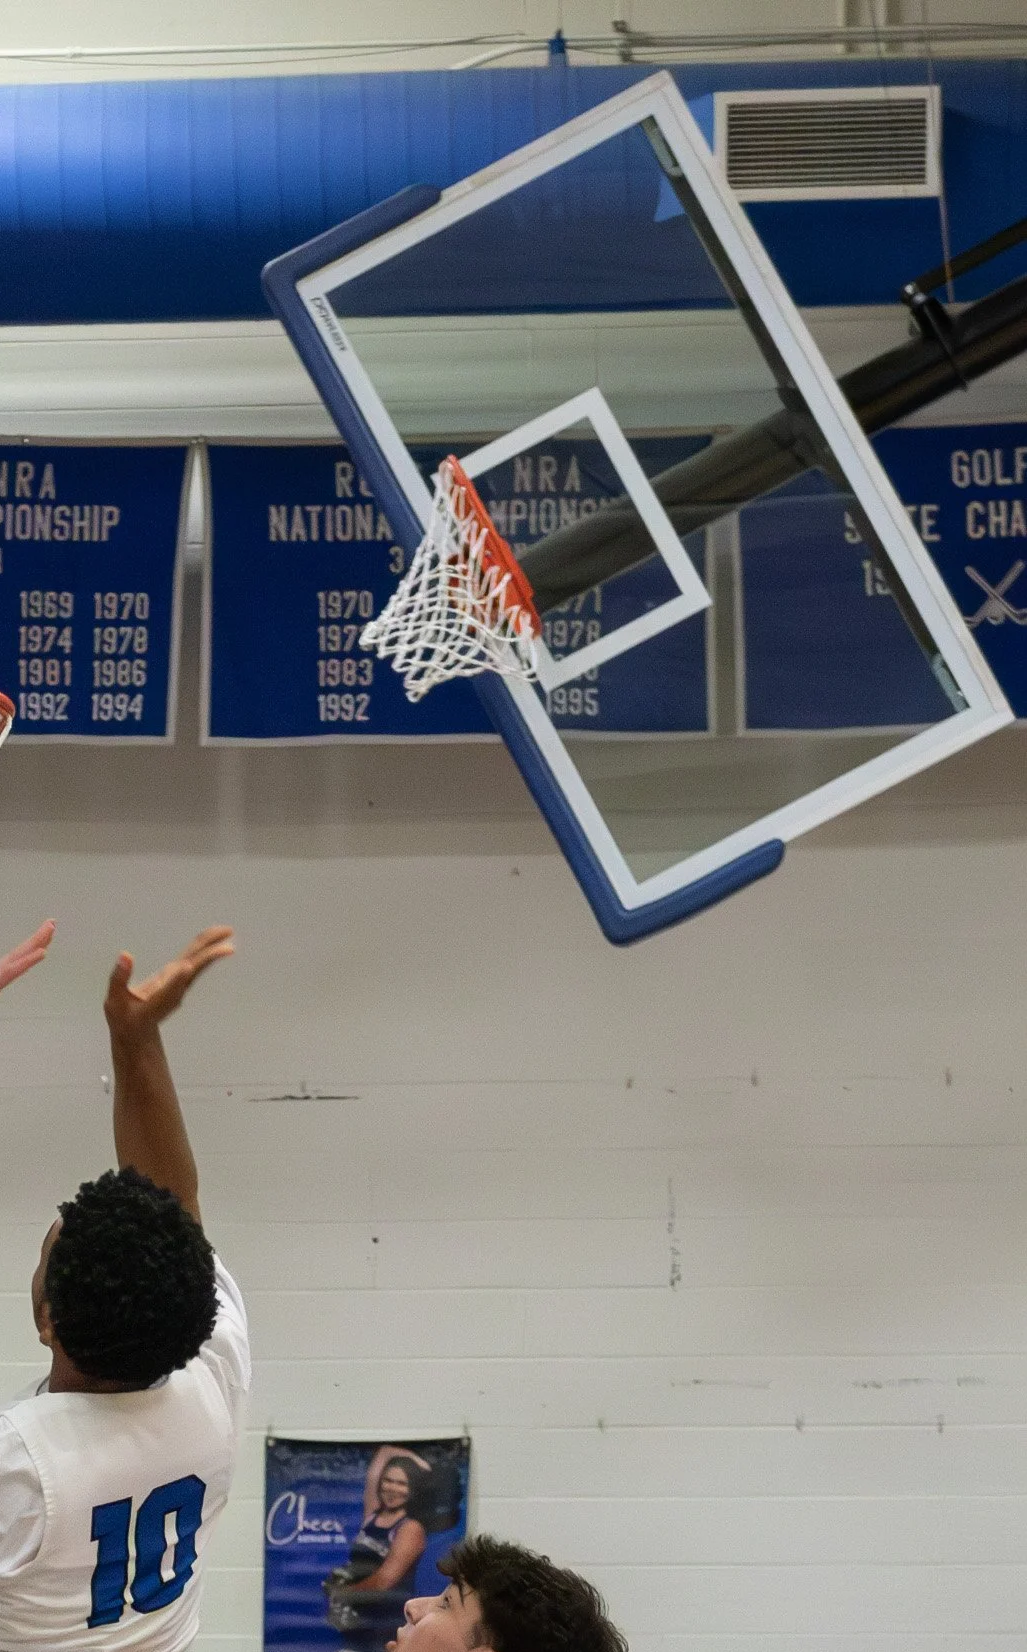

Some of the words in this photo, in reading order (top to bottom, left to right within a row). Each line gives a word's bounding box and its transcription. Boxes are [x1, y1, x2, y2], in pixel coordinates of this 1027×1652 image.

[513, 455, 581, 492] NRA
[951, 446, 1027, 488] GOLF
[268, 504, 394, 542] NATIONA
[19, 590, 74, 618] 1969
[93, 592, 149, 620] 1970
[317, 590, 373, 619] 1970
[19, 625, 72, 654] 1974
[93, 626, 148, 654] 1978
[18, 658, 72, 686] 1981
[93, 659, 147, 687] 1986
[317, 658, 373, 687] 1983
[19, 692, 70, 721] 1992
[92, 693, 143, 721] 1994
[317, 693, 371, 721] 1992
[87, 1474, 207, 1629] 10
